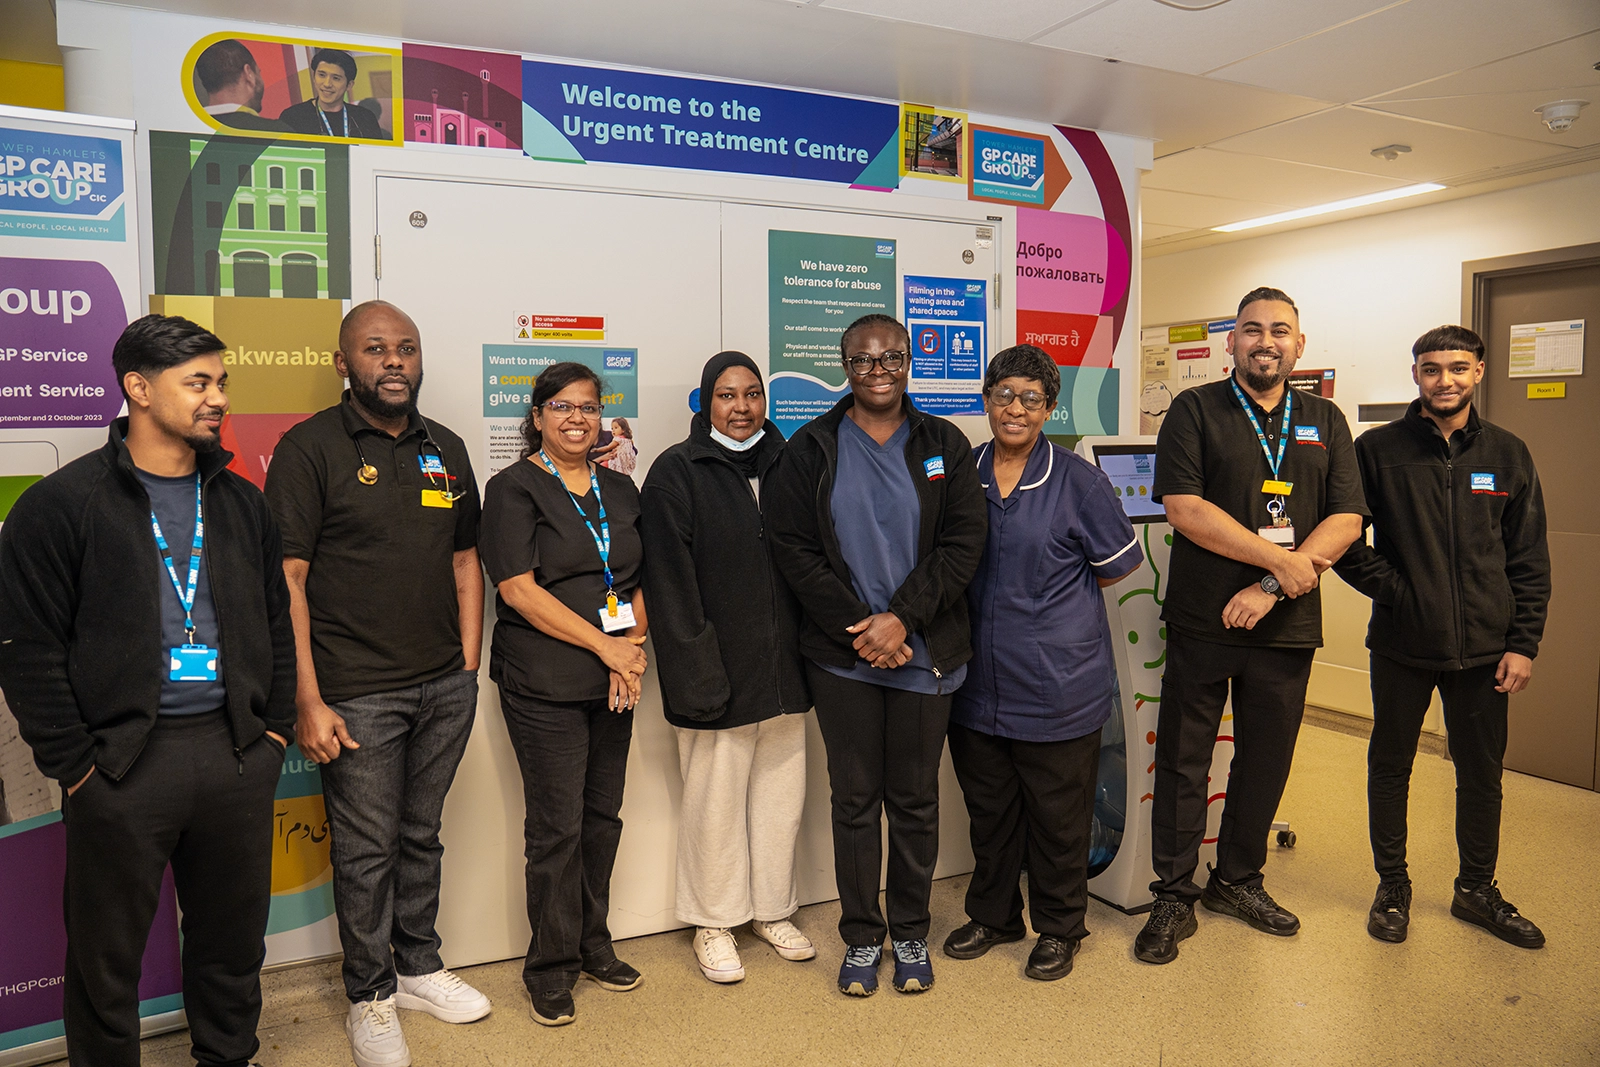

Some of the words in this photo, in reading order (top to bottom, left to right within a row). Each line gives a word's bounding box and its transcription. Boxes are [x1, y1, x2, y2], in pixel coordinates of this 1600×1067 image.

[562, 83, 681, 114] Welcome
[688, 98, 714, 117] to
[721, 100, 760, 122] the
[563, 115, 654, 144] Urgent
[661, 124, 788, 155] Treatment
[794, 138, 869, 164] Centre
[42, 147, 106, 160] HAMLETS
[982, 140, 1005, 148] TOWER
[1008, 144, 1036, 154] HAMLETS
[982, 147, 1001, 161] GP
[1002, 150, 1036, 168] CARE
[30, 158, 106, 183] CARE
[982, 160, 1029, 178] GROUP
[89, 194, 107, 202] CIC
[1016, 241, 1062, 262] Добро
[800, 260, 817, 270] We
[819, 261, 844, 272] have
[846, 265, 868, 274] zero
[1016, 265, 1104, 284] пожаловать
[784, 276, 833, 288] tolerance
[835, 278, 850, 288] for
[851, 279, 882, 290] abuse
[909, 286, 934, 296] Filming
[782, 297, 804, 305] Respect
[909, 297, 935, 307] waiting
[909, 307, 933, 315] shared
[21, 348, 88, 362] Service
[223, 346, 333, 366] akwaaba
[489, 356, 515, 365] Want
[517, 357, 528, 365] to
[529, 356, 556, 366] make
[489, 375, 498, 385] a
[0, 384, 33, 397] ent
[39, 384, 105, 397] Service
[489, 391, 520, 406] give
[523, 394, 531, 404] a
[541, 454, 549, 462] NHS
[548, 464, 556, 474] NHS
[152, 522, 162, 537] NHS
[196, 522, 204, 537] NHS
[168, 566, 178, 582] NHS
[188, 568, 198, 584] NHS
[186, 588, 195, 604] NHS
